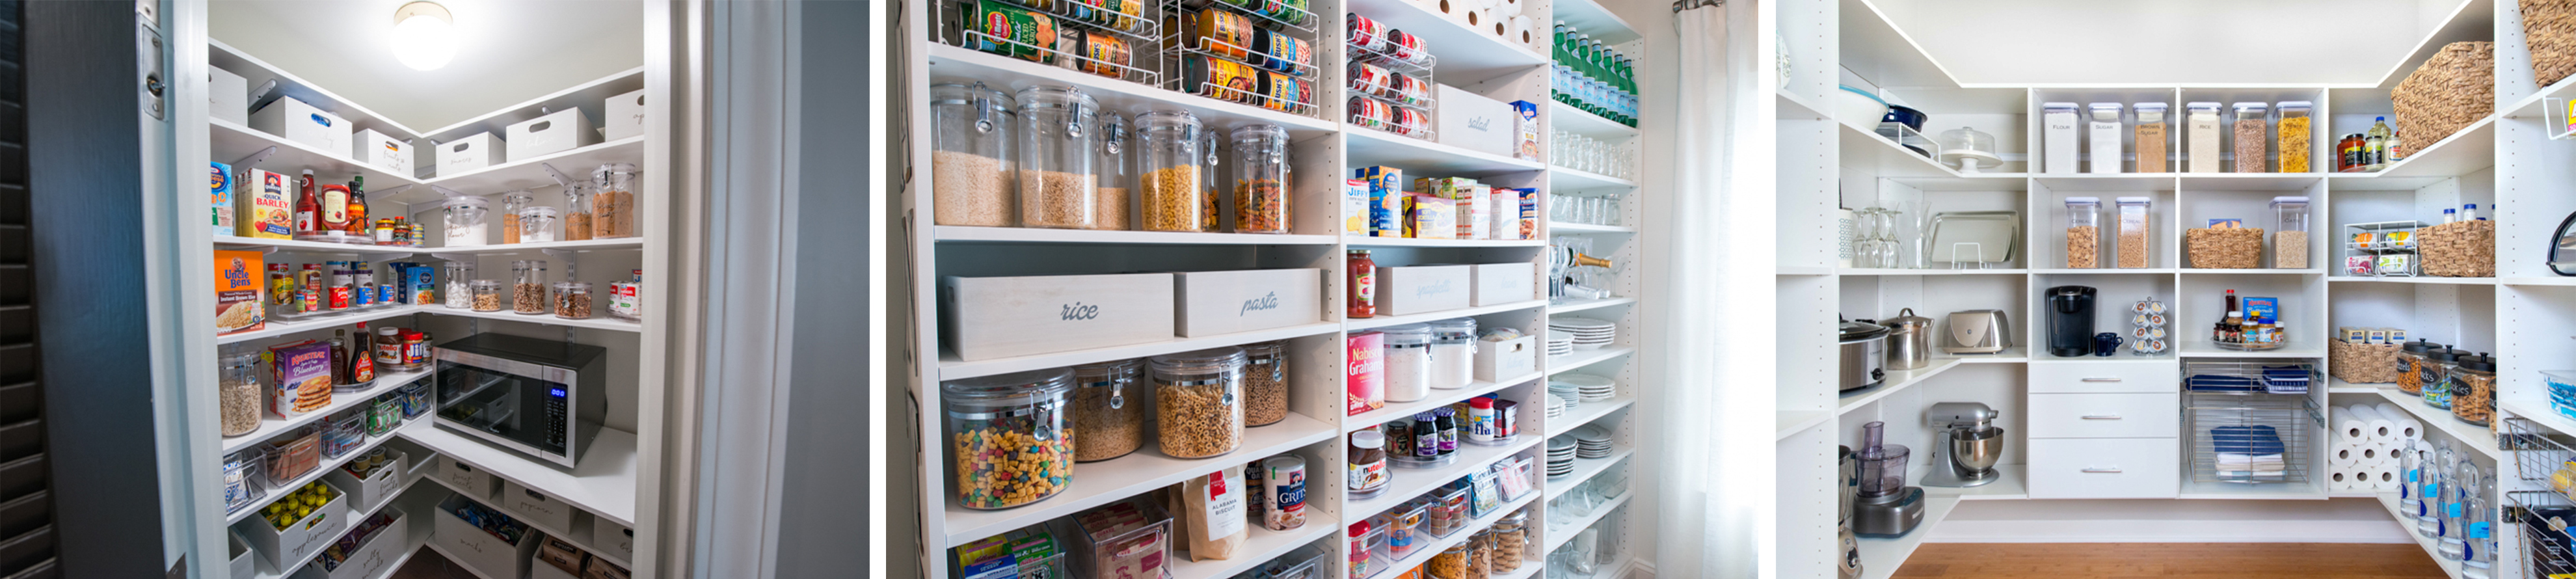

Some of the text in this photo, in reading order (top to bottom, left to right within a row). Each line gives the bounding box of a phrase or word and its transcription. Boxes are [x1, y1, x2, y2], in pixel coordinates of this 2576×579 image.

[1274, 33, 1282, 58] BUSH'S
[1468, 116, 1489, 132] salad
[256, 197, 289, 209] BARLEY
[224, 269, 248, 280] Uncle
[230, 278, 251, 289] Ben's
[1416, 279, 1450, 299] spaghetti
[1060, 301, 1099, 321] rice
[1240, 291, 1278, 317] pasta
[377, 342, 397, 351] nutella
[291, 351, 325, 366] KRUSTEAZ
[1353, 347, 1382, 362] Nabisco
[293, 363, 323, 377] Blueberry
[1349, 360, 1384, 376] Grahams
[1363, 459, 1386, 474] nutella
[520, 501, 552, 515] popcorn
[1213, 498, 1237, 510] ALABAMA
[1215, 505, 1235, 515] BISCUIT
[292, 522, 336, 557] applesauce
